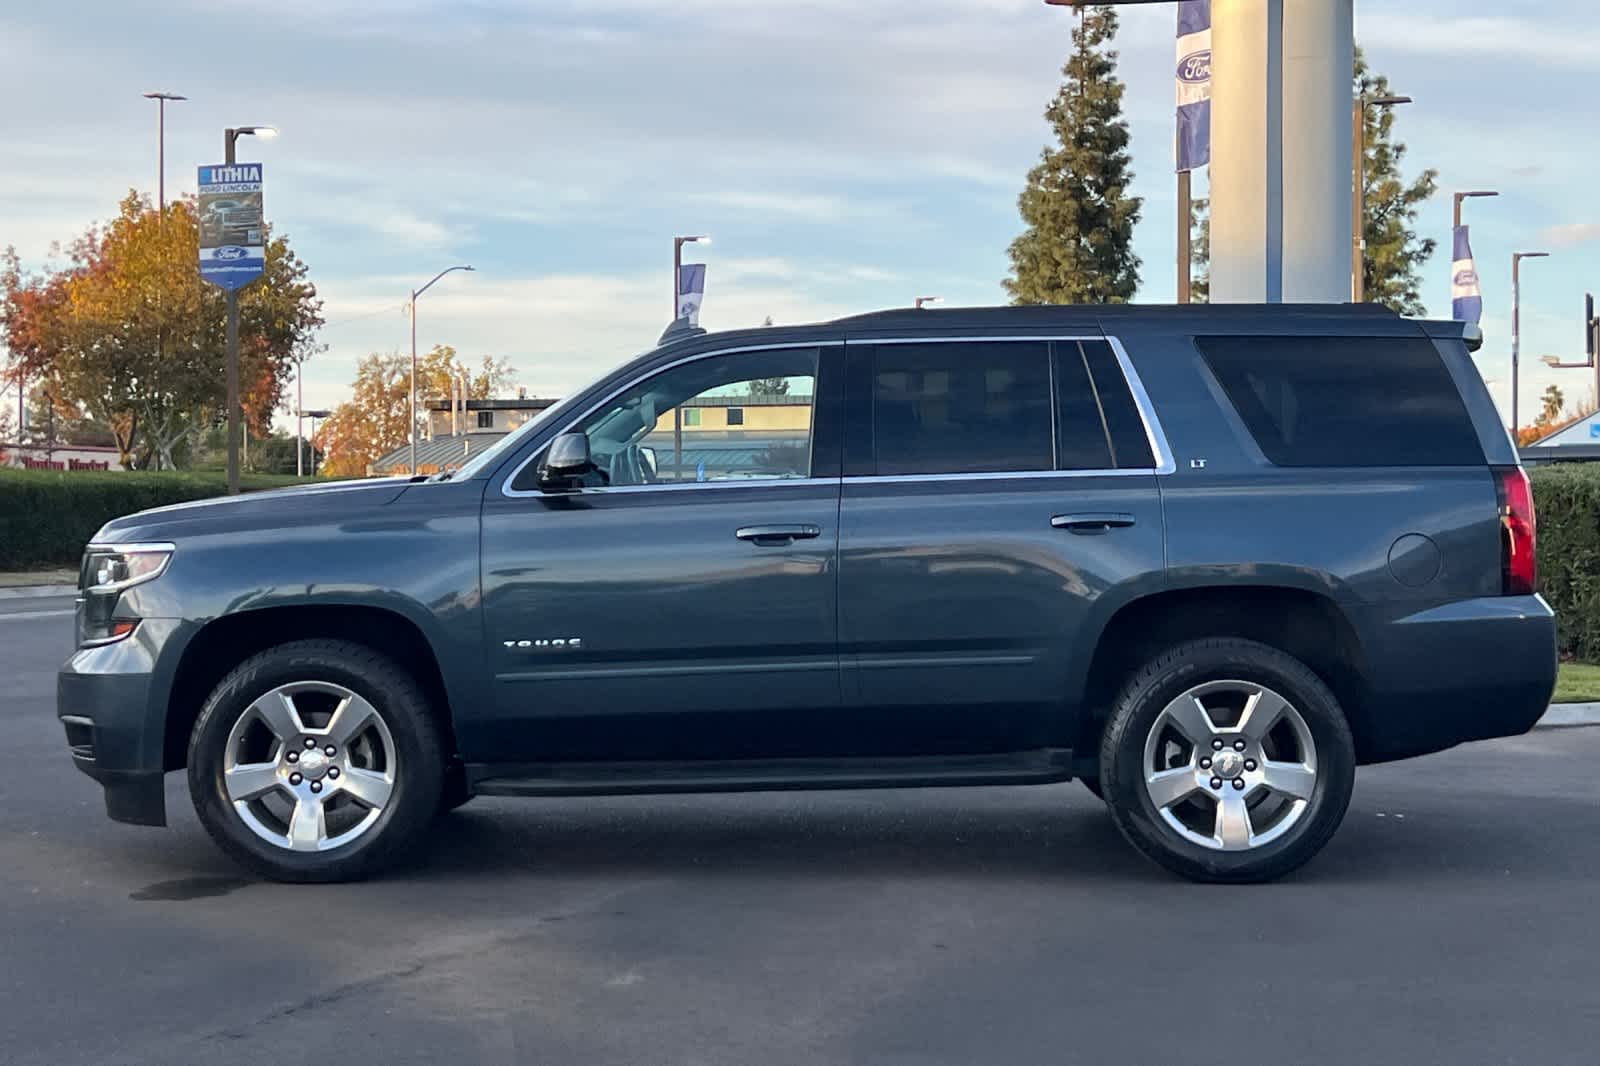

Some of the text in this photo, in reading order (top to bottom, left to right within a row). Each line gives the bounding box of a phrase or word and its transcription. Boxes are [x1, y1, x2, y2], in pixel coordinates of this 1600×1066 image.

[1185, 56, 1211, 79] For
[211, 167, 260, 183] LITHIA
[223, 184, 260, 192] LINCOLN
[218, 246, 242, 260] Ford
[1190, 459, 1207, 468] LT
